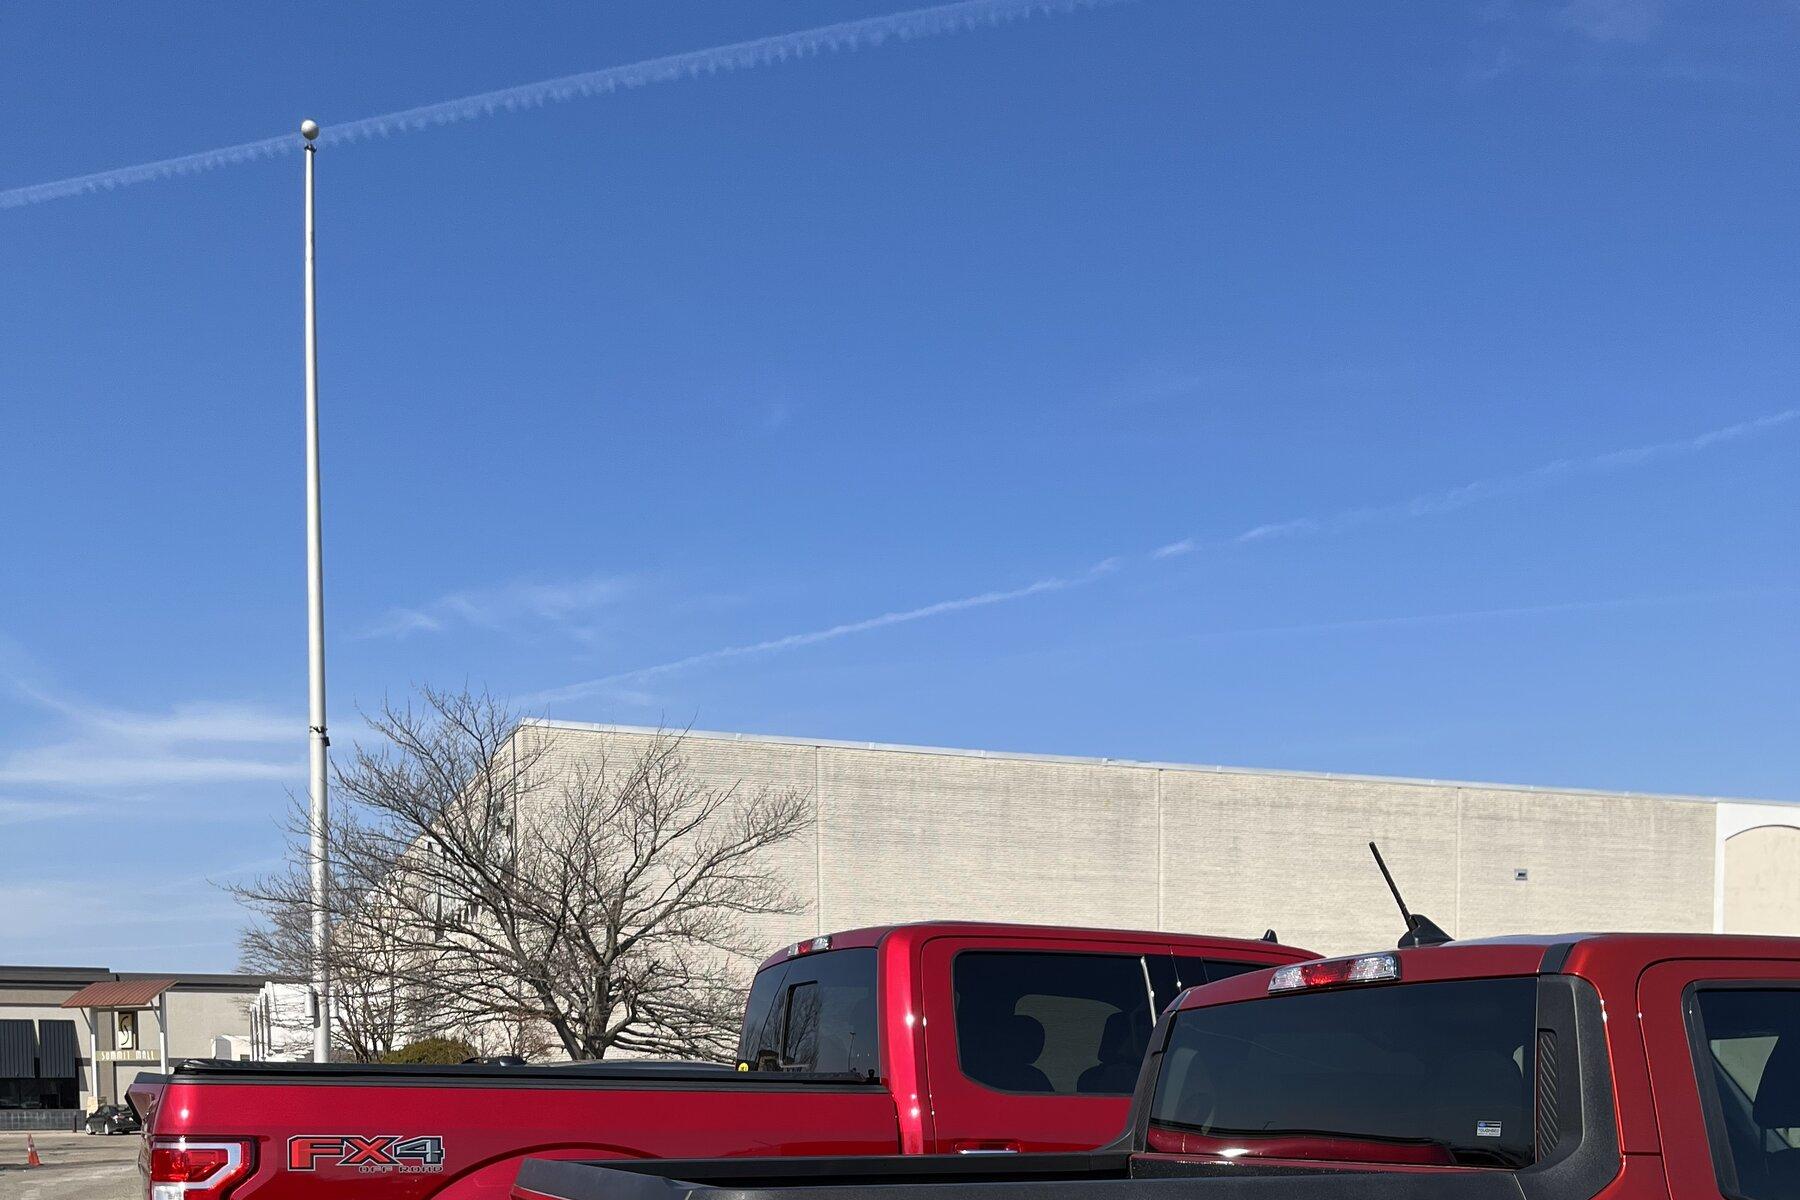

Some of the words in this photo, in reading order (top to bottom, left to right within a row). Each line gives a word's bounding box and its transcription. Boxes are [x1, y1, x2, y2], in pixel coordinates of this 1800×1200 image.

[101, 1051, 130, 1061] SUMMIT
[135, 1050, 155, 1062] MALL
[287, 1135, 446, 1172] FX4
[358, 1165, 393, 1174] OFF
[399, 1165, 444, 1174] ROAD
